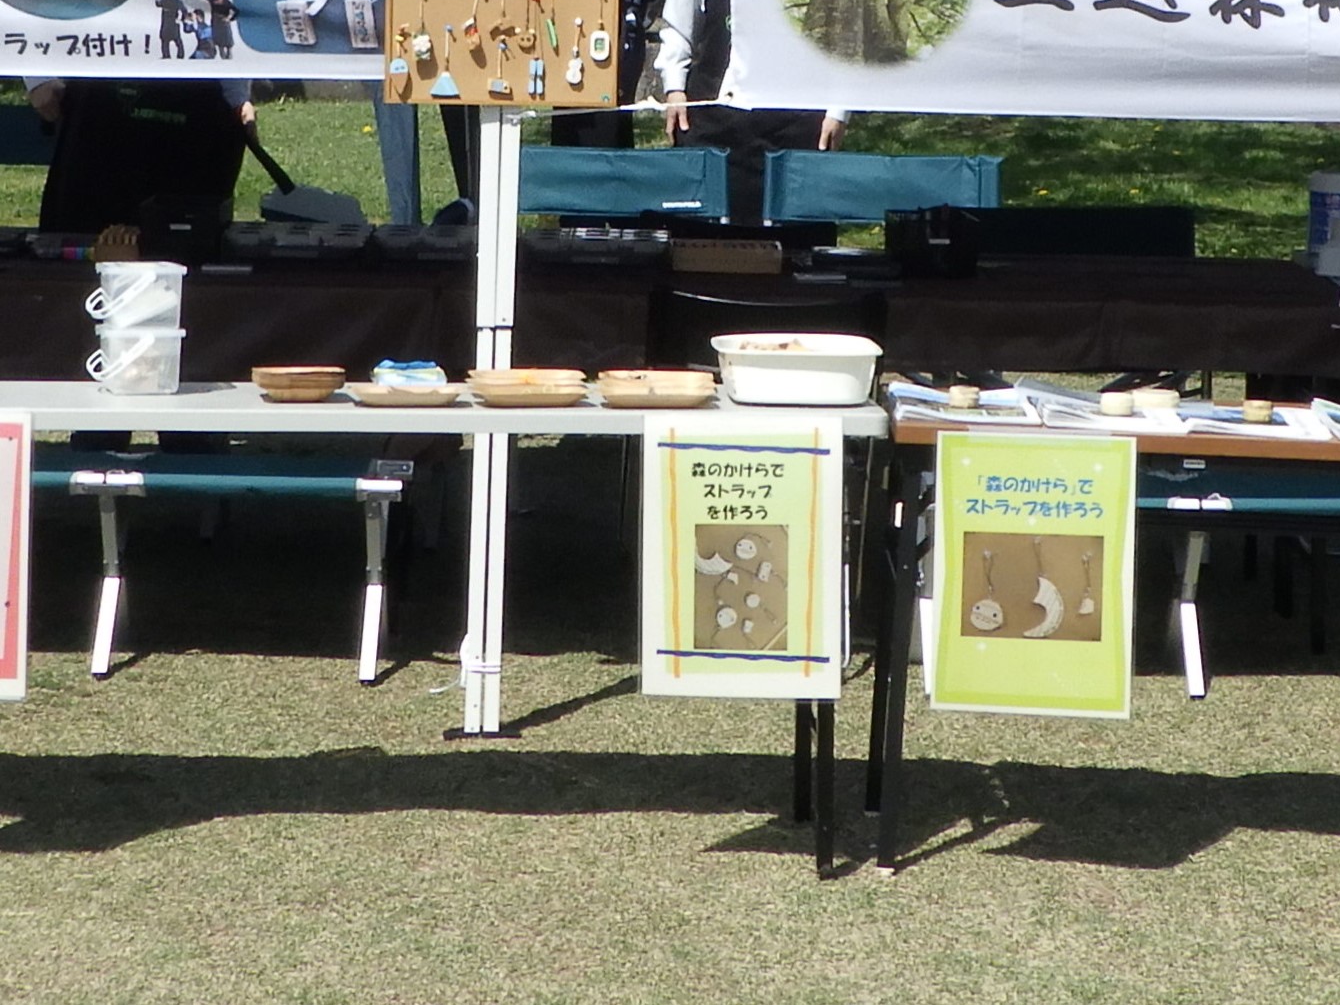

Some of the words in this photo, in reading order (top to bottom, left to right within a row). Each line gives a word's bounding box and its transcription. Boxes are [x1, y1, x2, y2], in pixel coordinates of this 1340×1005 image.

[691, 462, 785, 478] 森のかけらで
[706, 504, 769, 521] を作ろう
